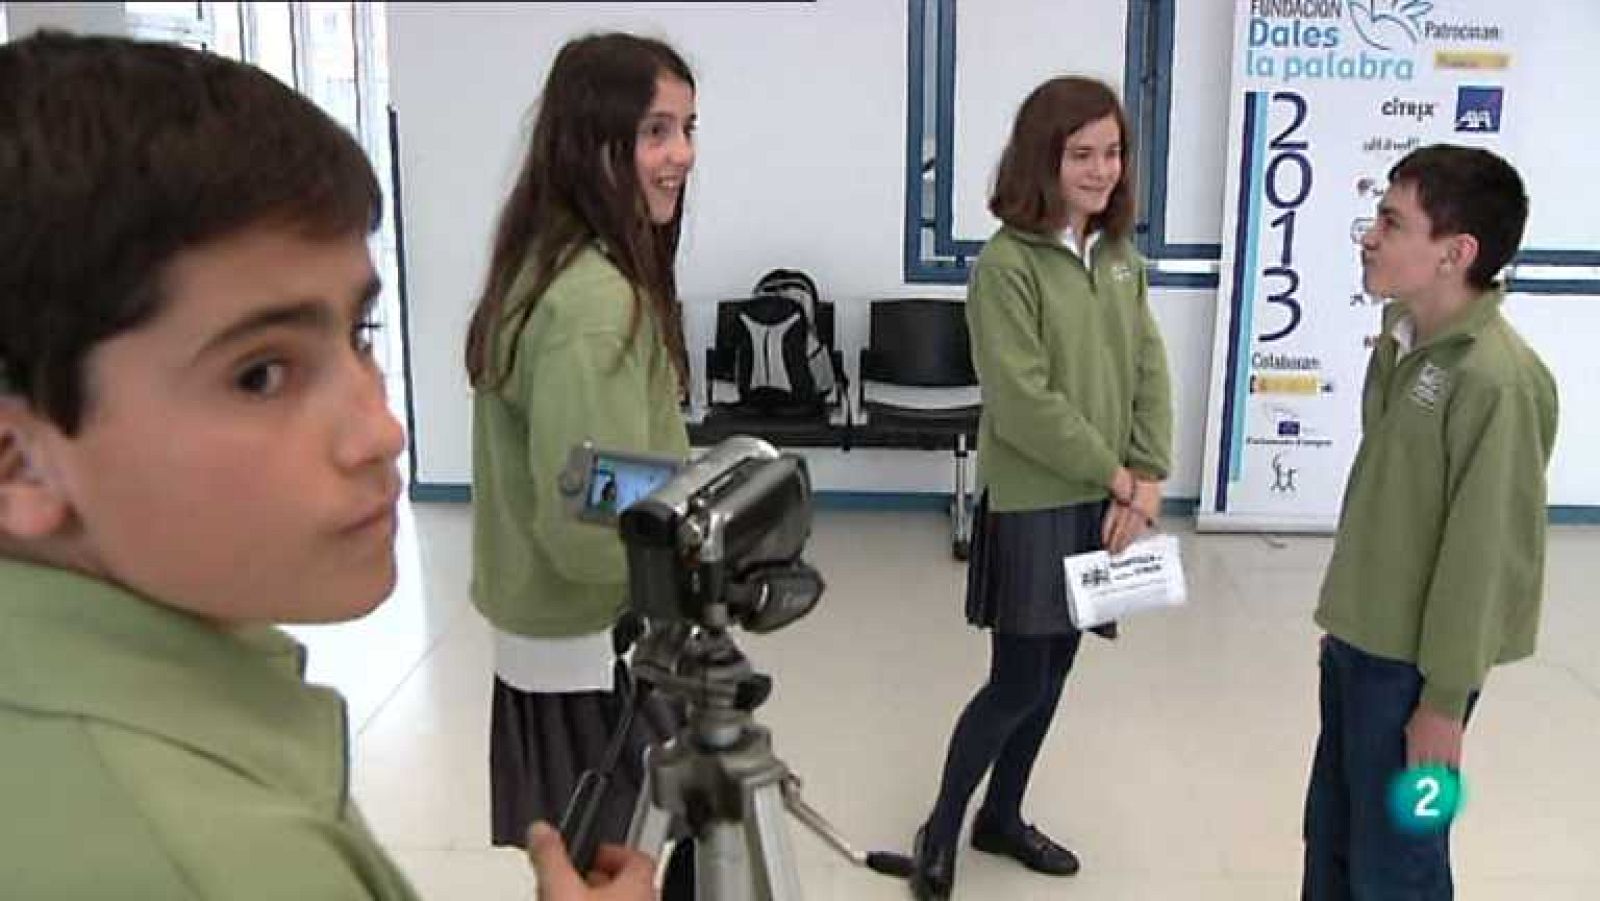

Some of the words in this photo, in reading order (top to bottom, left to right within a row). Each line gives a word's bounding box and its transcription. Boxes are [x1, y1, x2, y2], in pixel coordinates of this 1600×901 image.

[1249, 18, 1339, 48] Dales
[1245, 50, 1274, 77] la
[1283, 51, 1414, 81] palabra
